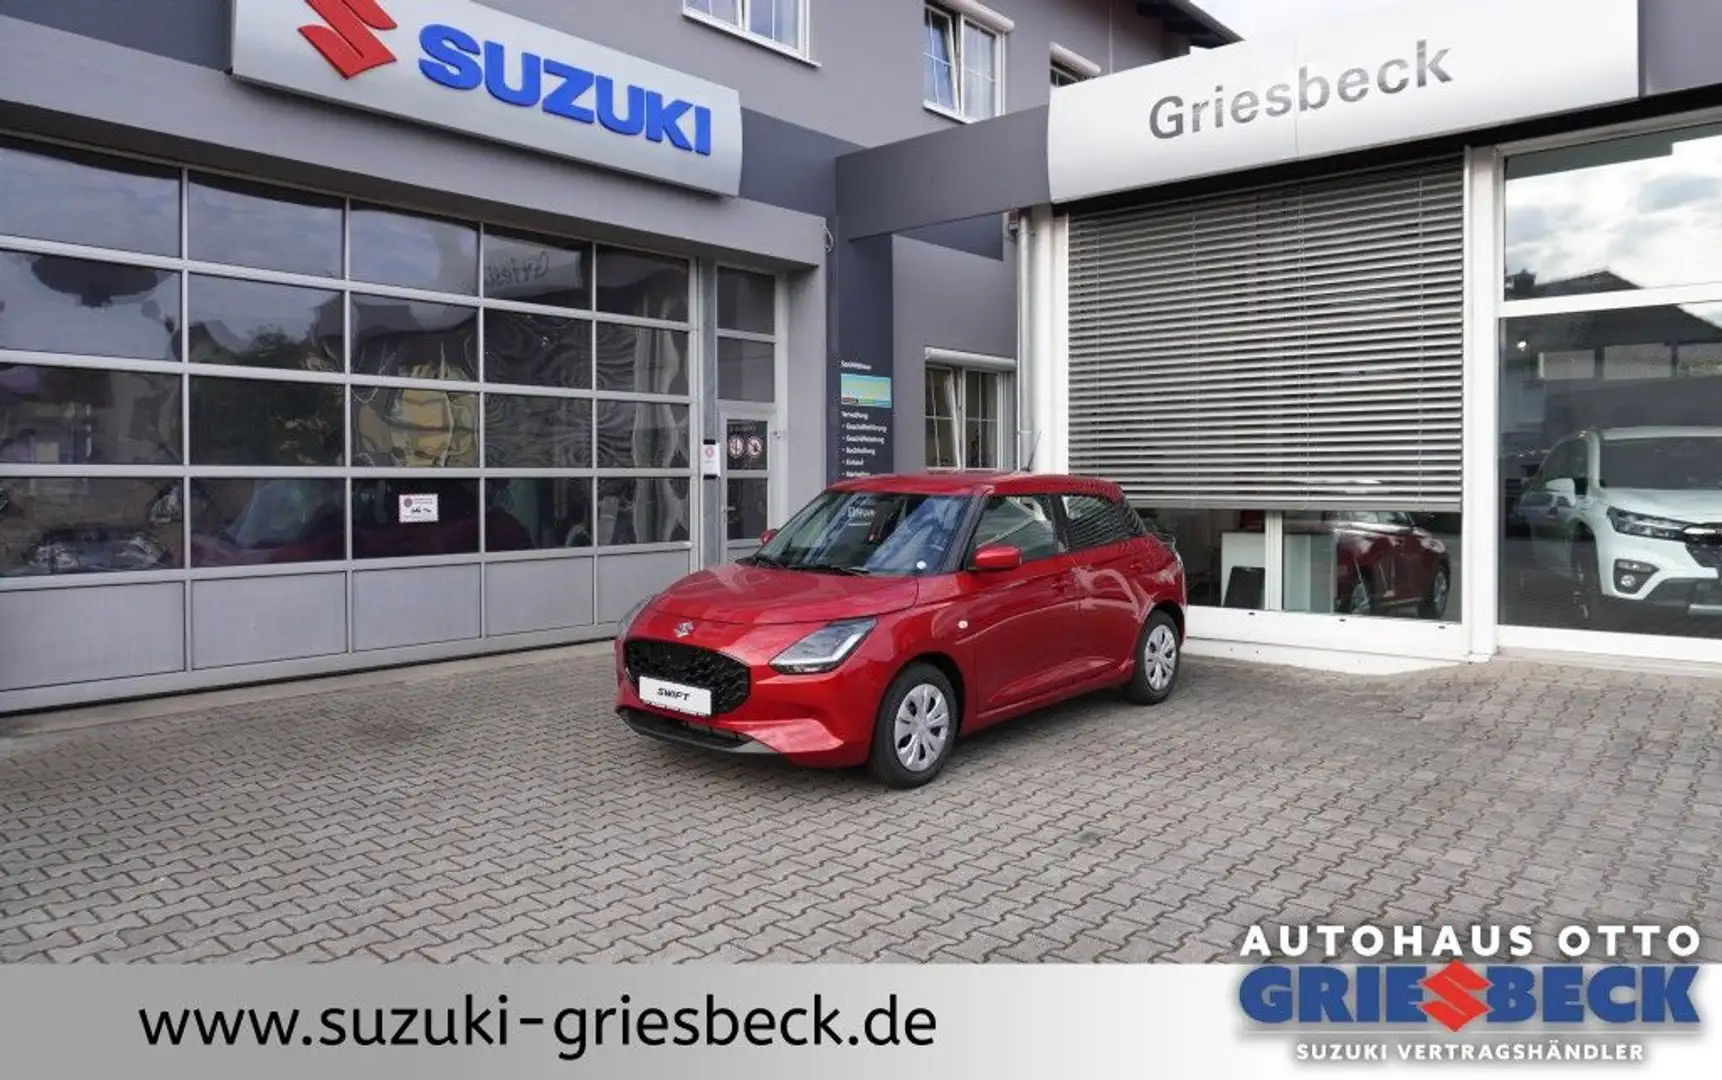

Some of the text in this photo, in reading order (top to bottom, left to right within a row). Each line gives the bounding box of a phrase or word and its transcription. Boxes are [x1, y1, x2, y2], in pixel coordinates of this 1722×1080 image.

[417, 23, 713, 157] SUZUKI
[1149, 39, 1453, 139] Griesbeck
[656, 687, 691, 701] SWIFT
